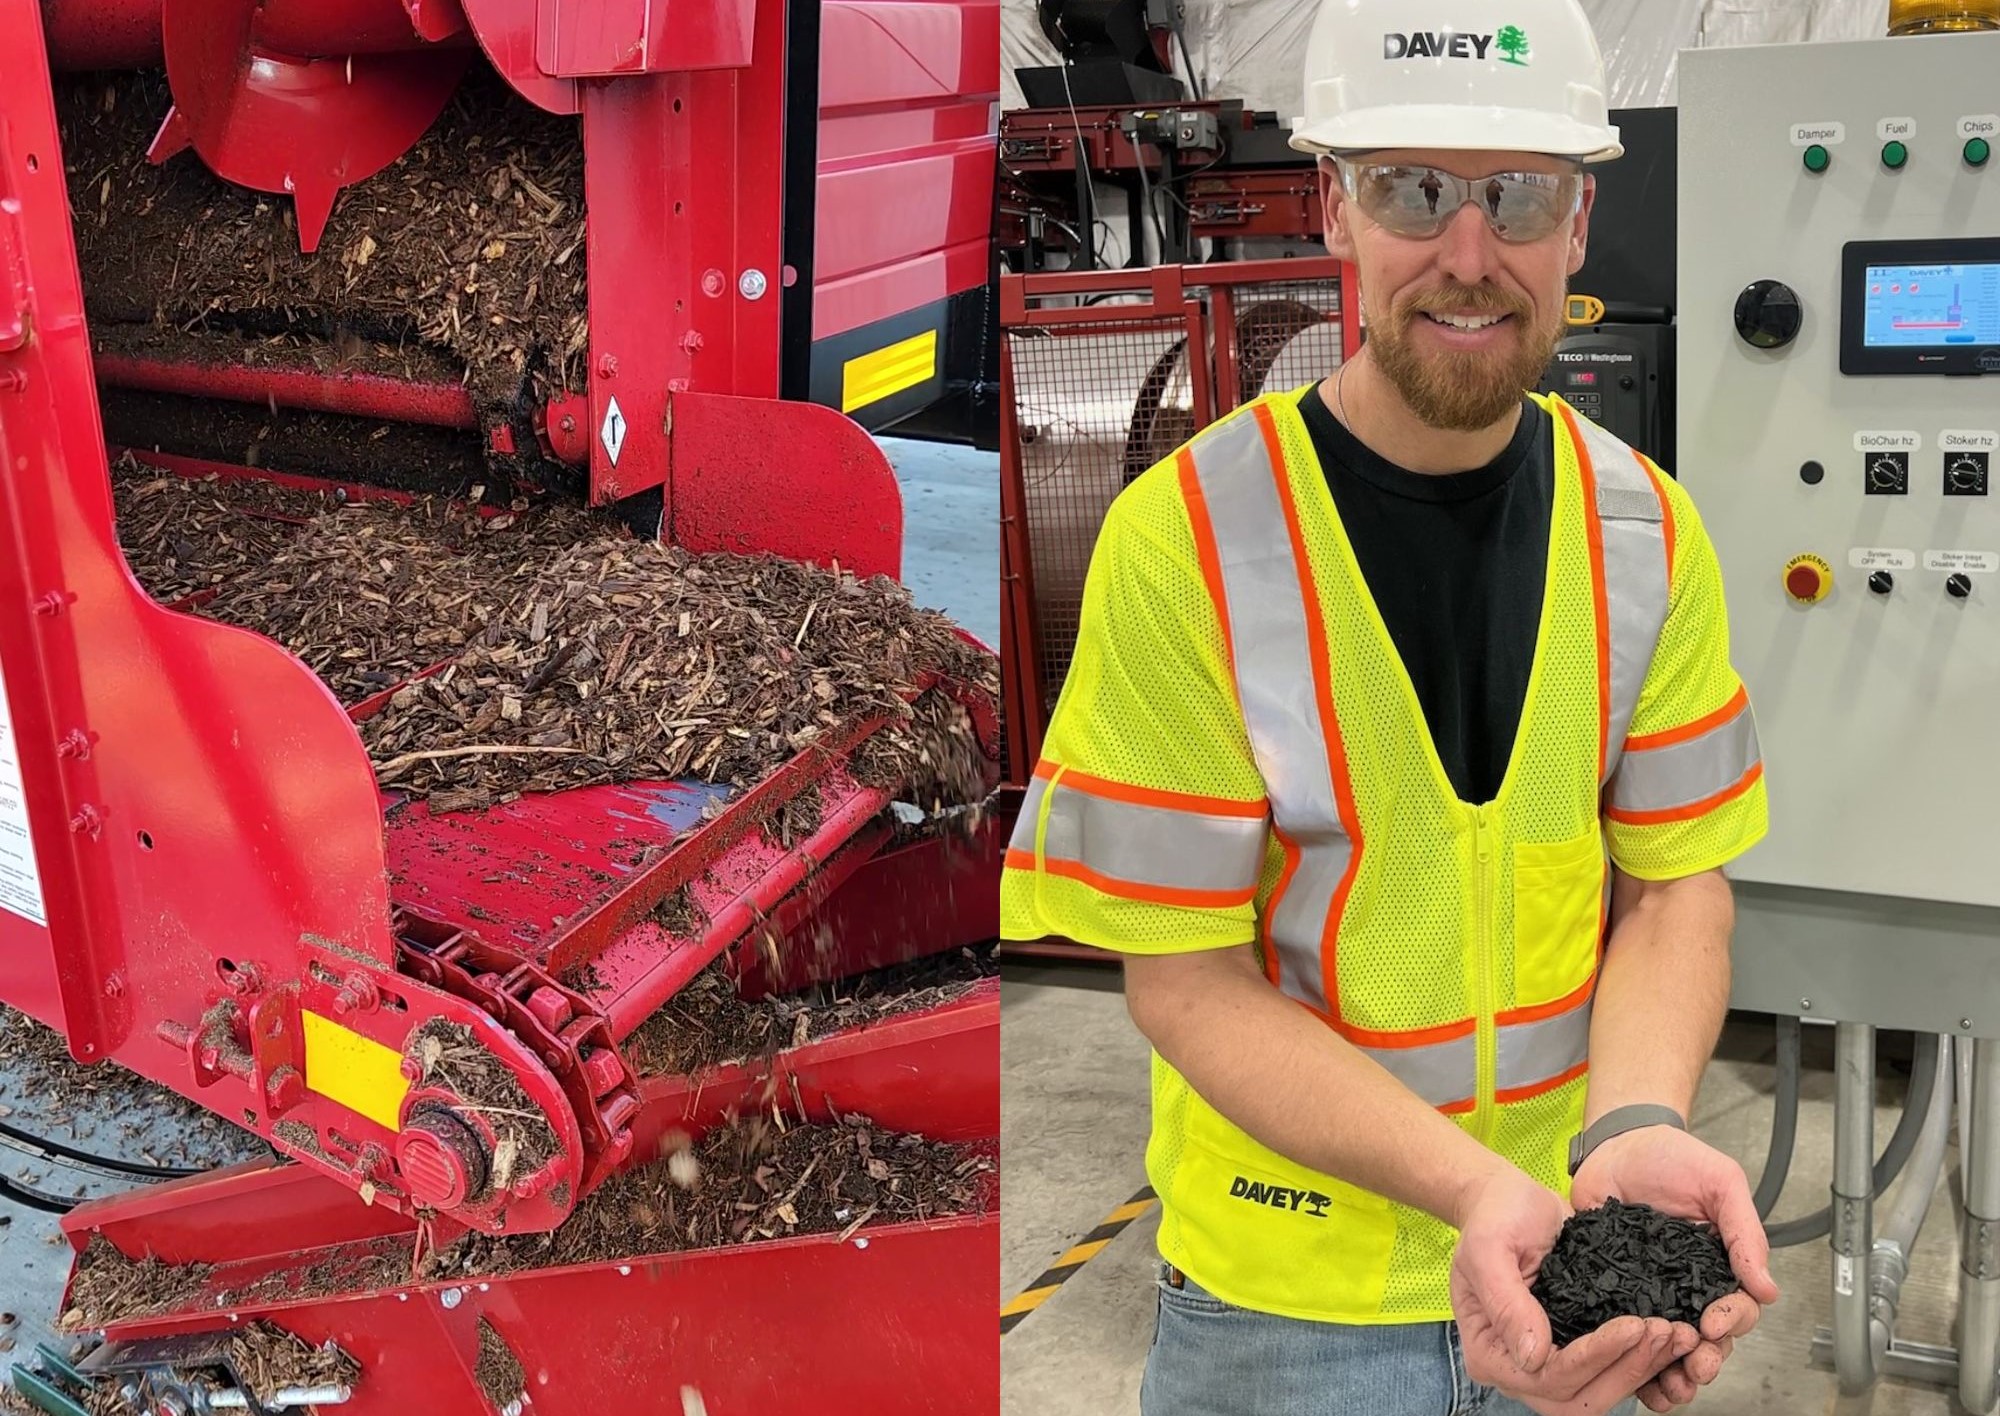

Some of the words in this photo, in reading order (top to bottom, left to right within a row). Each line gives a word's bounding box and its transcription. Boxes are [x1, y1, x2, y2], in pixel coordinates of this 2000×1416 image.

[1384, 32, 1492, 60] DAVEY
[1885, 123, 1908, 134] Fuel
[1963, 121, 1993, 132] Chips
[1797, 129, 1836, 140] Damper
[1557, 354, 1584, 362] TECO
[1590, 354, 1633, 363] Westinghouse
[1860, 436, 1899, 446] BioChar
[1902, 436, 1914, 446] hz
[1945, 435, 1978, 446] Stoker
[1981, 436, 1993, 446] hz
[1786, 554, 1830, 571] EMERGENCY
[1229, 1176, 1306, 1211] DAVEY
